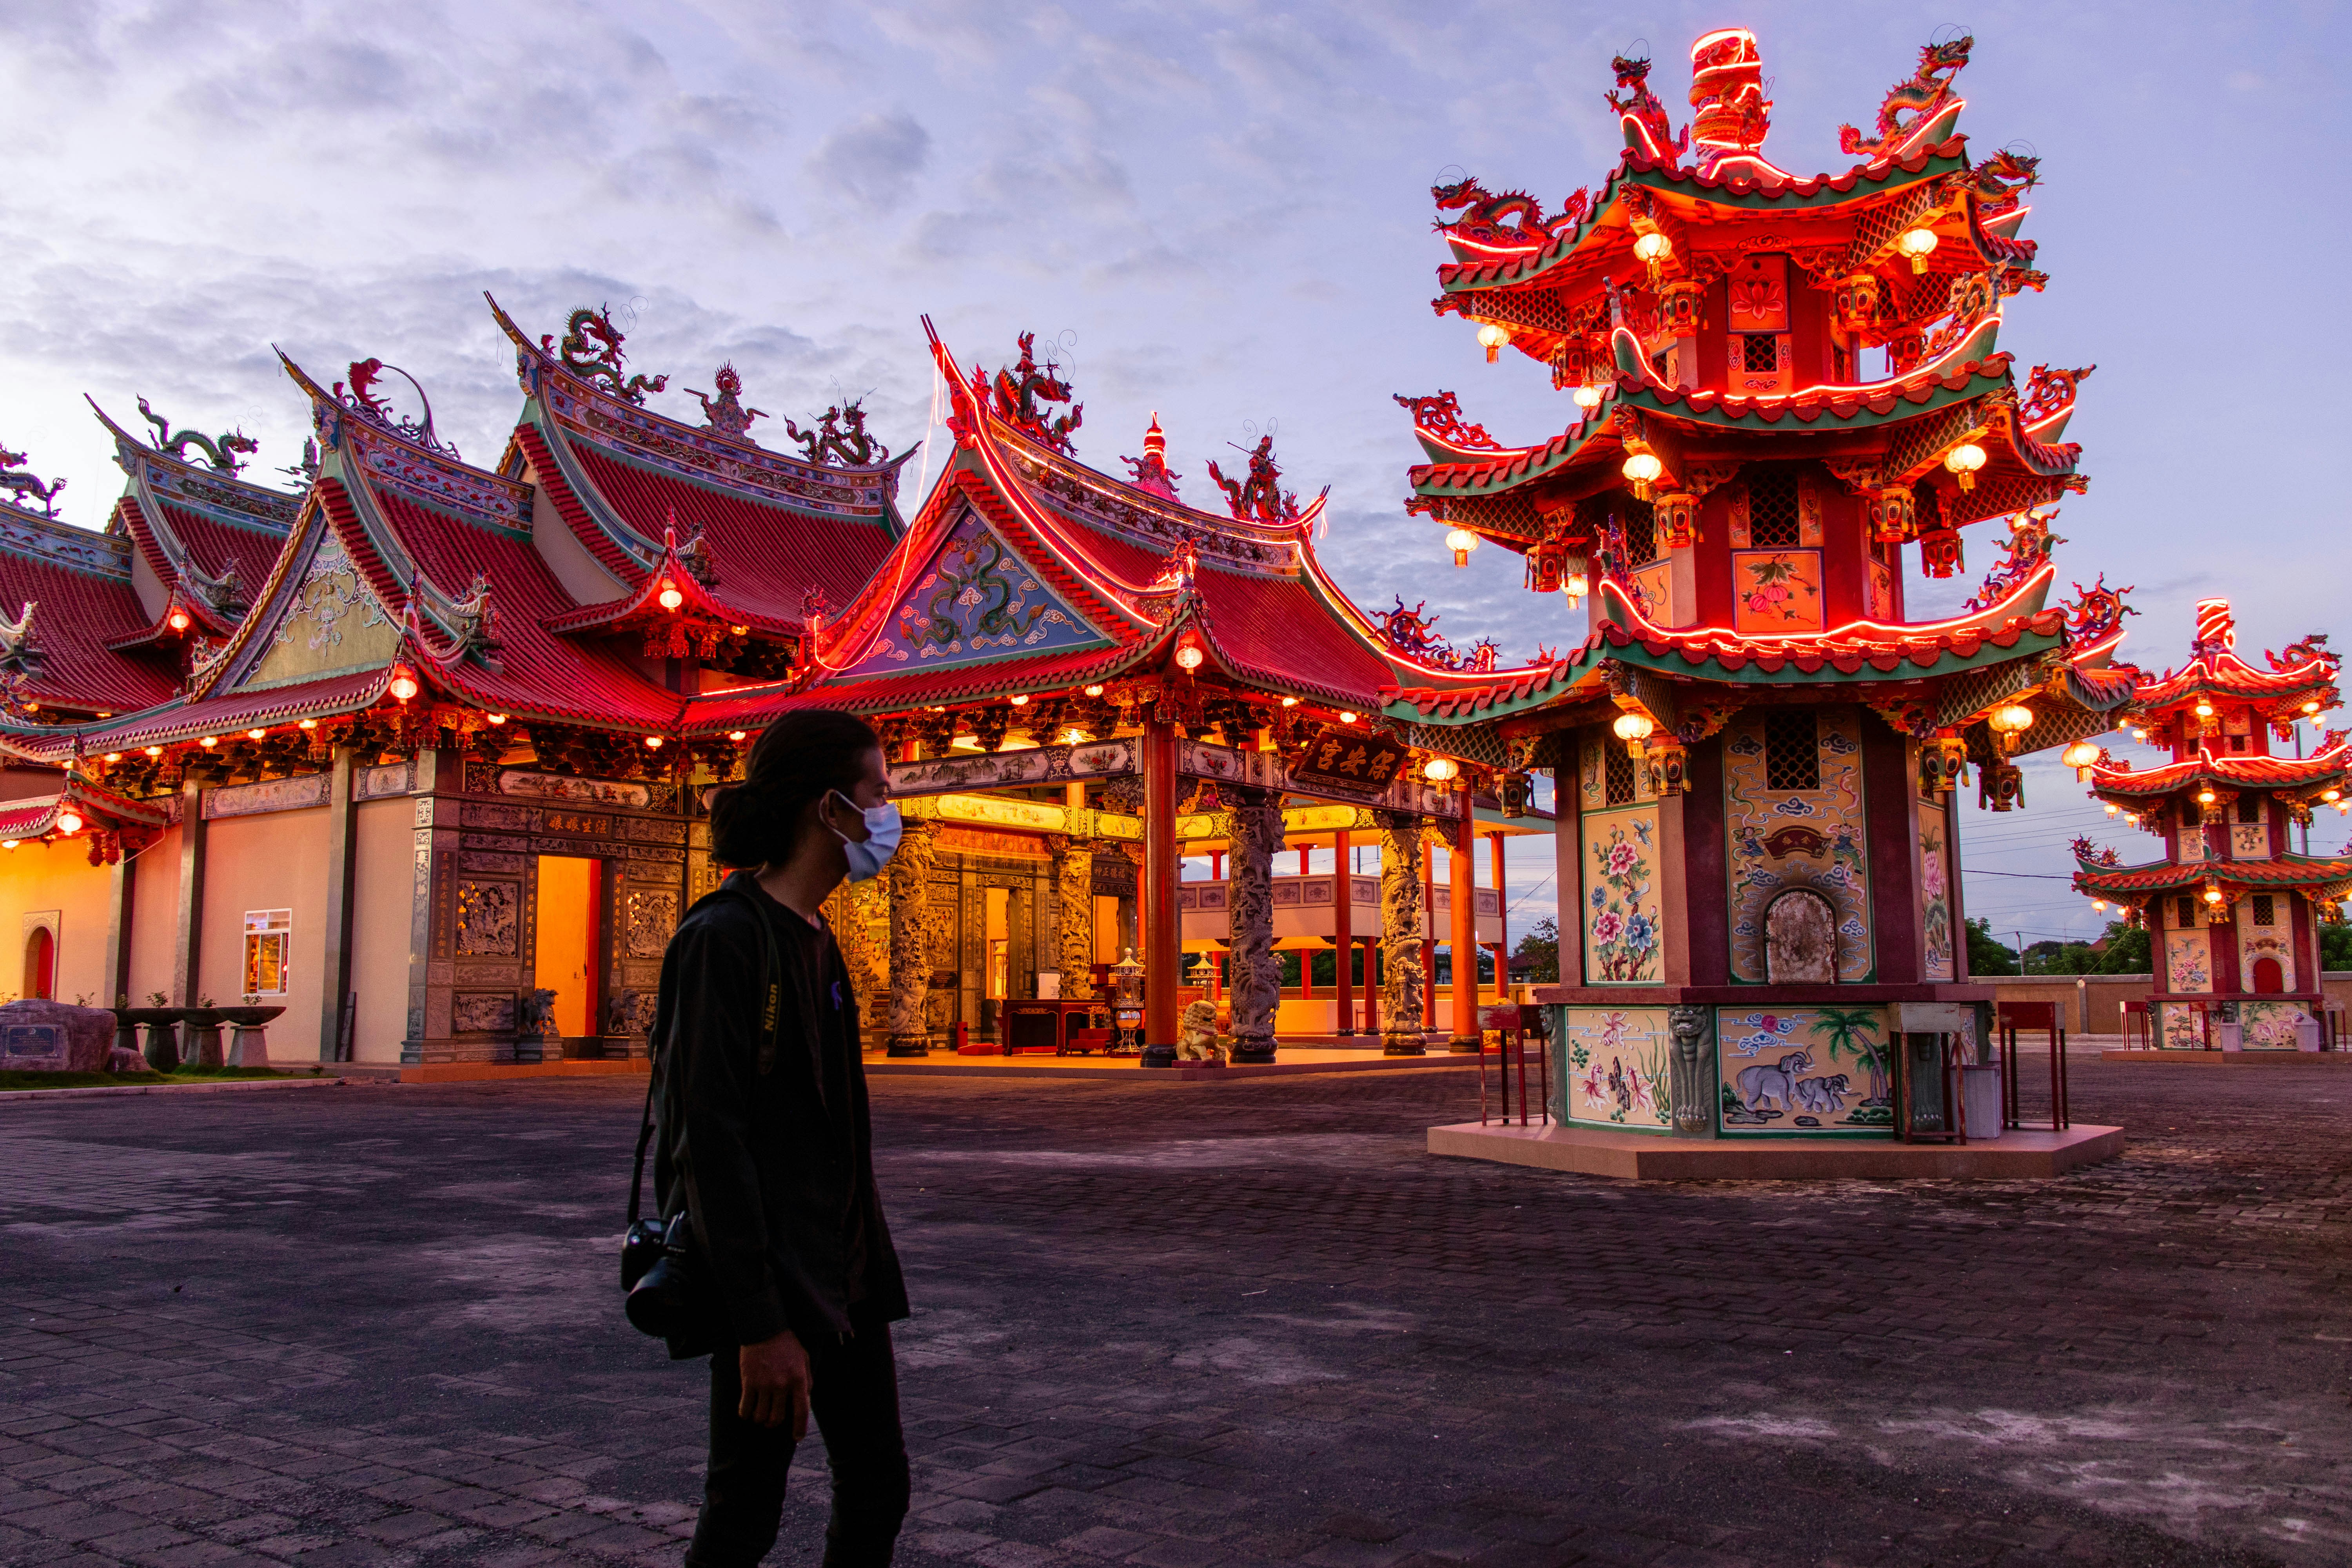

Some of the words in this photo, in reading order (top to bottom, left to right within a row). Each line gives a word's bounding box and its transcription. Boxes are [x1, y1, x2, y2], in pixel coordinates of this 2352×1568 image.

[1094, 866, 1125, 878] 福德正神
[765, 984, 777, 1031] Nikon
